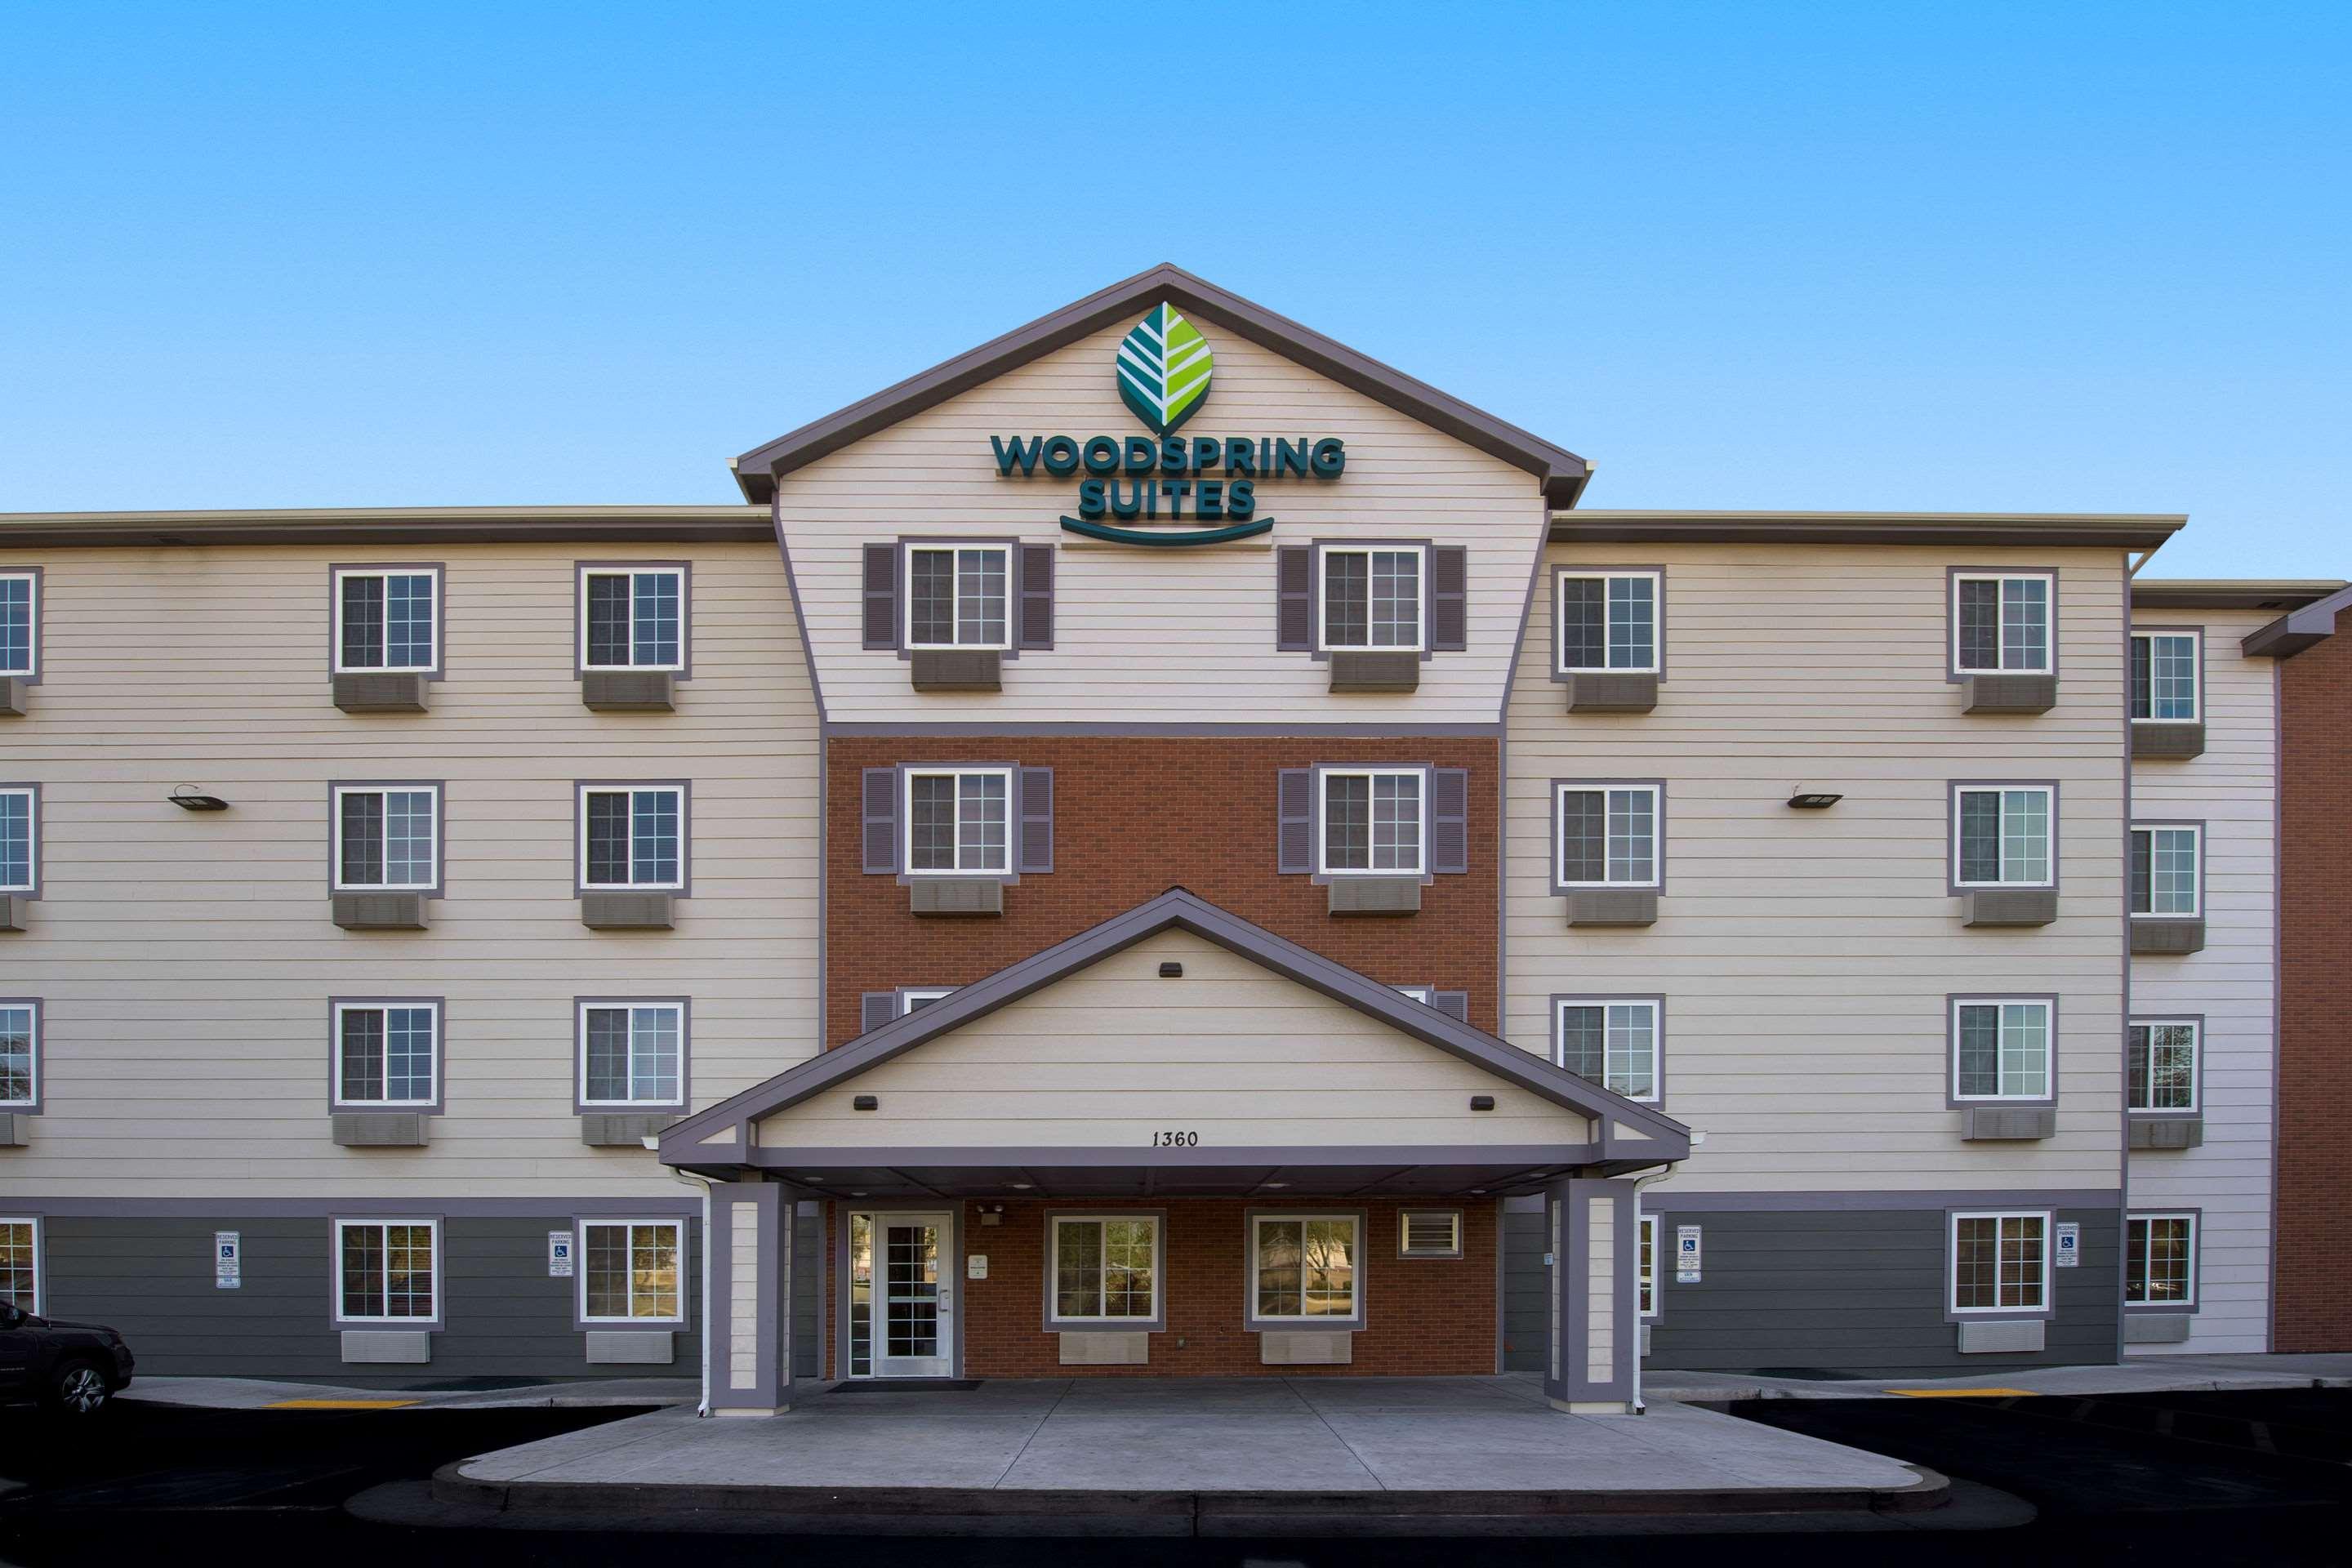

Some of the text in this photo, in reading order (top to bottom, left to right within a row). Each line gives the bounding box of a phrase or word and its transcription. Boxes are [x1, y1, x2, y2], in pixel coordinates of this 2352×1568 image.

[990, 435, 1345, 479] WOODSPRING
[1078, 479, 1255, 520] SUITES
[1153, 1131, 1198, 1147] 1360
